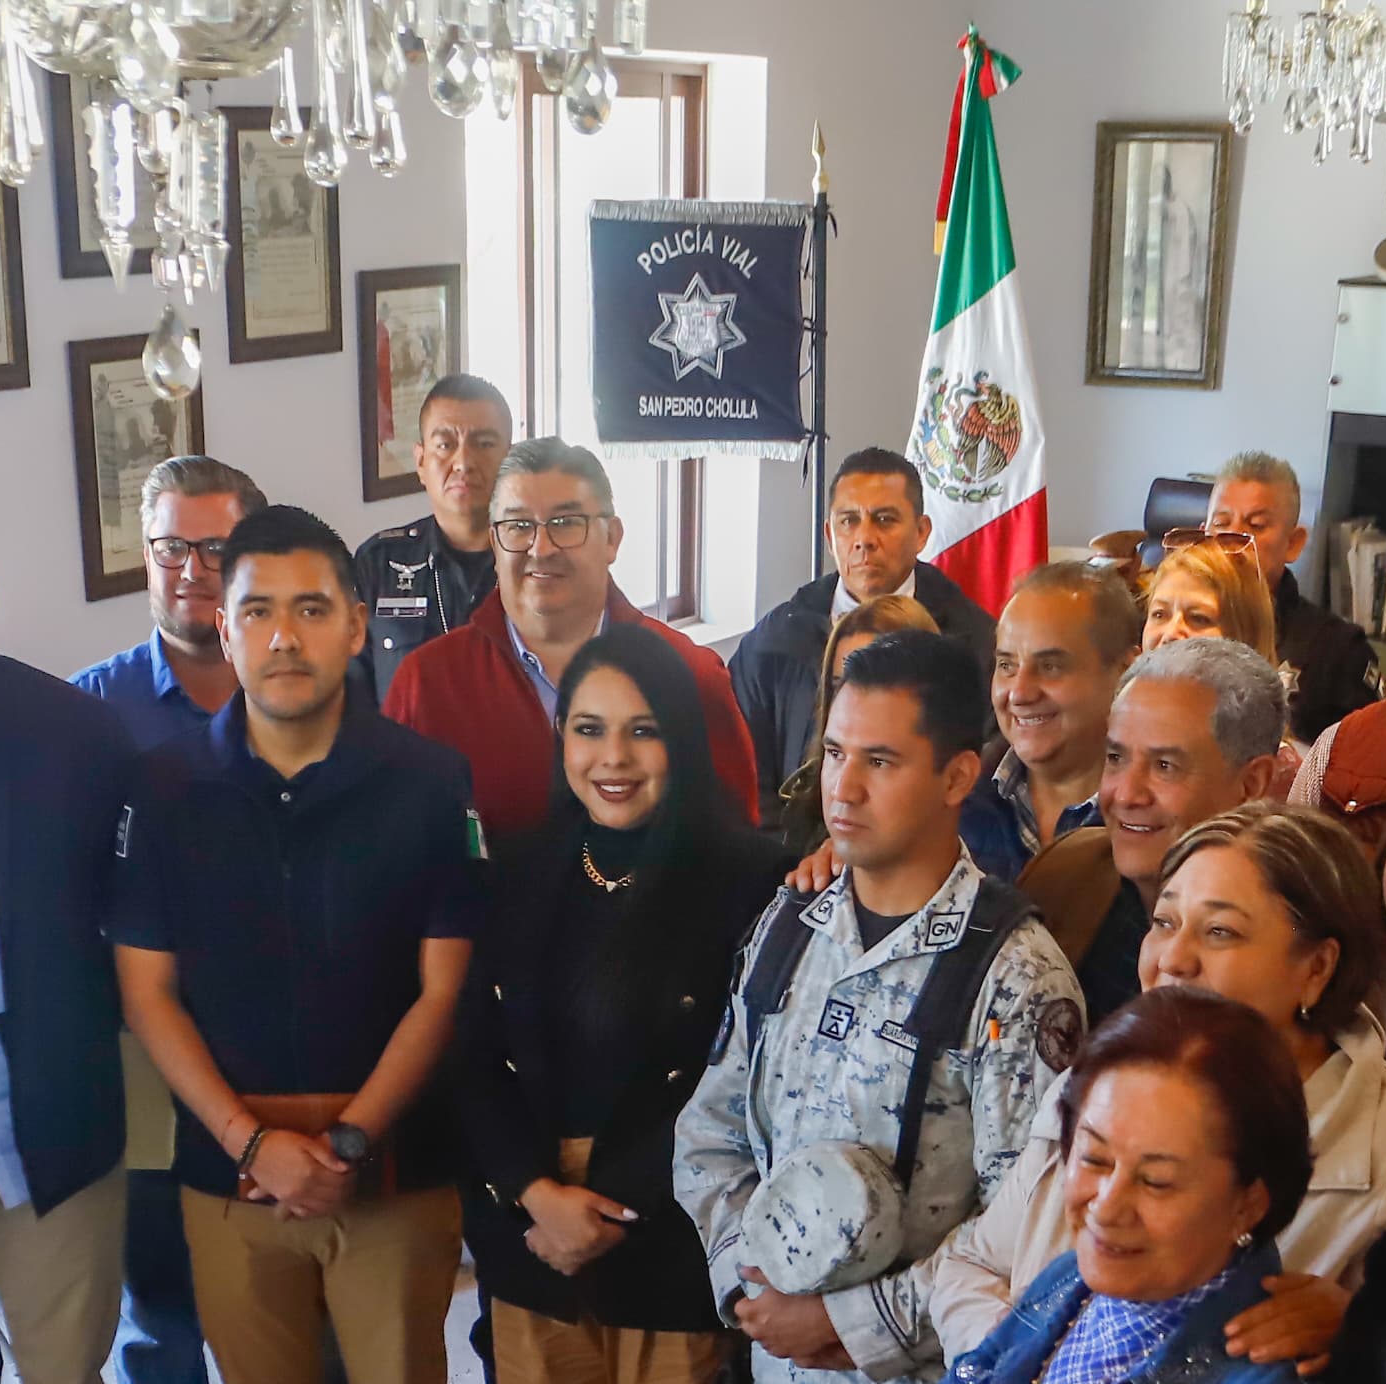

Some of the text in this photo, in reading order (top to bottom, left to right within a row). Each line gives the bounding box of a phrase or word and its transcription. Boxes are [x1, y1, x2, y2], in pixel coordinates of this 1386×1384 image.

[636, 224, 758, 279] POLICÍA VIAL
[638, 395, 758, 419] SAN PEDRO CHOLULA
[932, 921, 958, 937] GN
